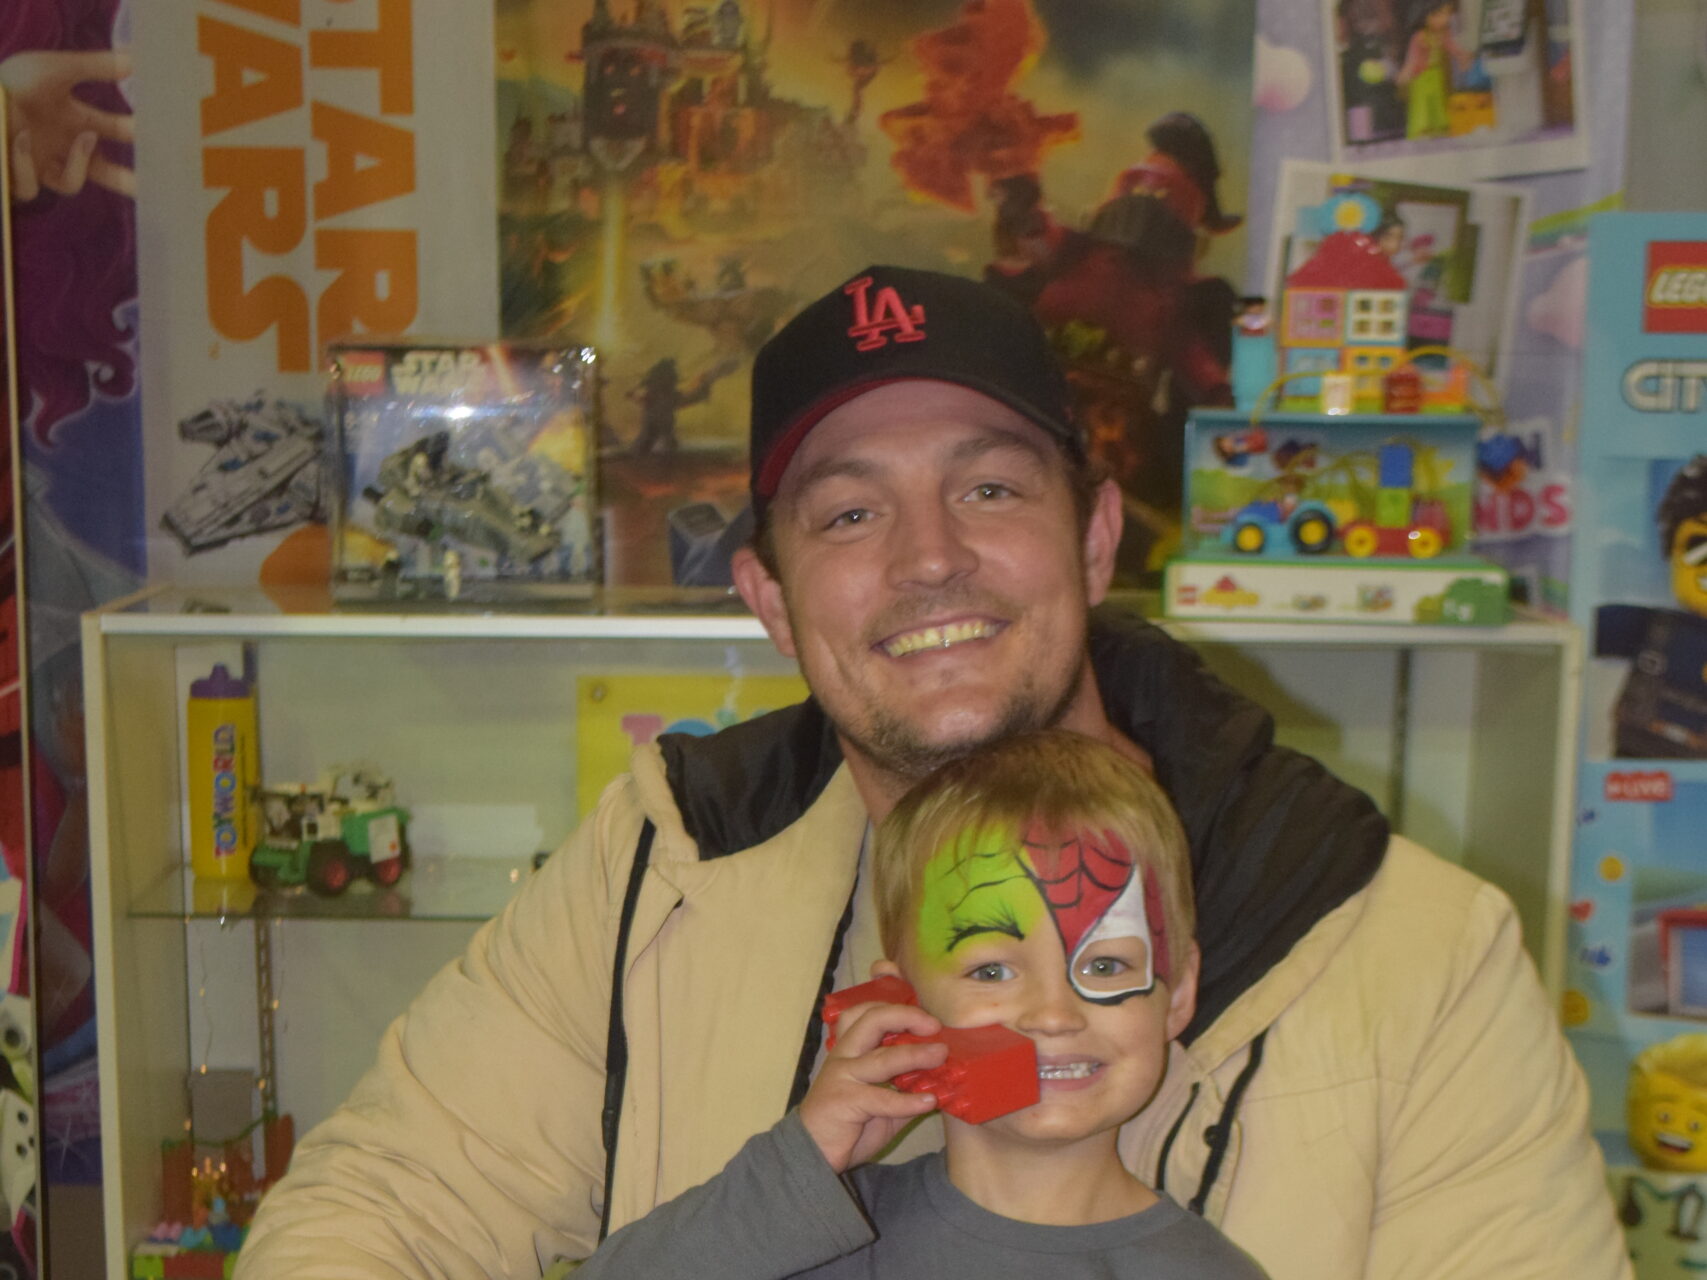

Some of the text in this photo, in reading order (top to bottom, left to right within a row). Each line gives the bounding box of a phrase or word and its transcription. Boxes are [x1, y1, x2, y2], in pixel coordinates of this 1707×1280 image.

[198, 0, 311, 373] ARS
[309, 0, 419, 371] TAR
[843, 276, 926, 352] LA
[1650, 268, 1707, 307] LEG
[1621, 357, 1707, 415] CIT
